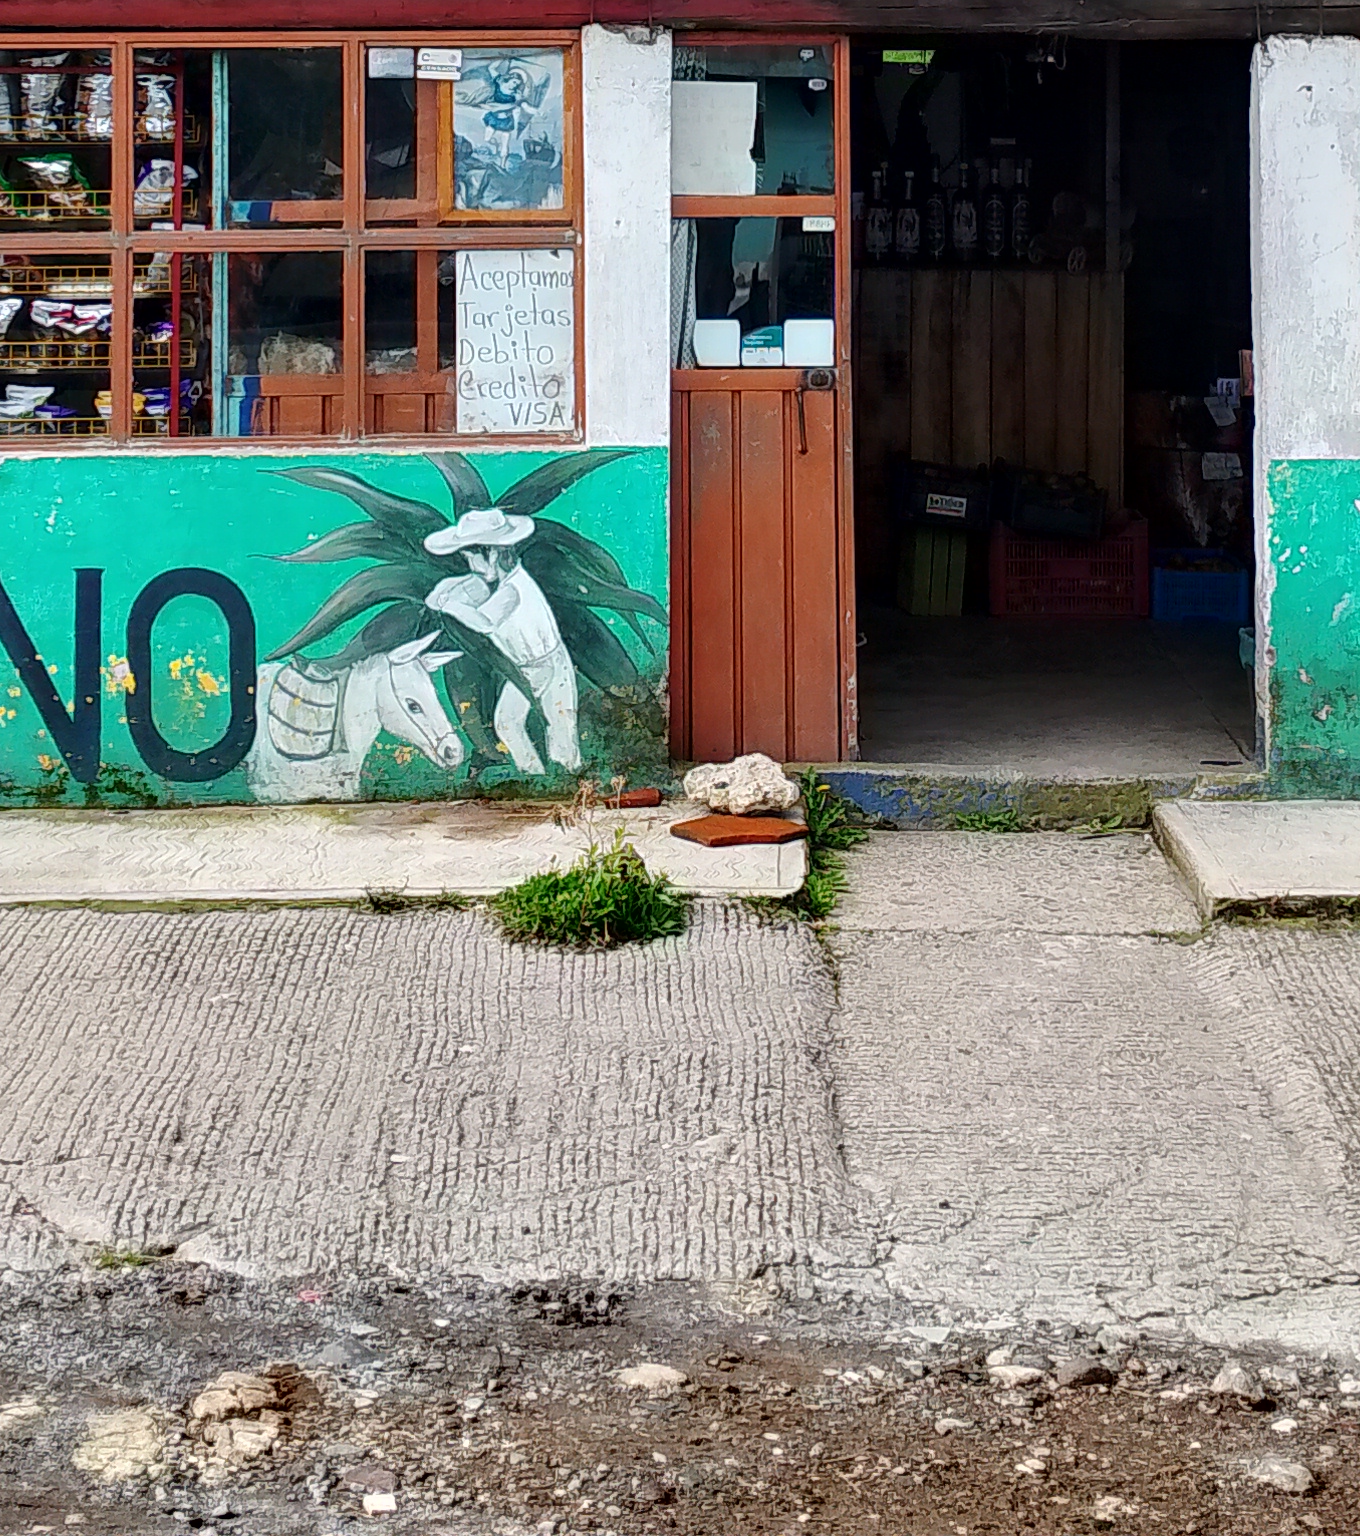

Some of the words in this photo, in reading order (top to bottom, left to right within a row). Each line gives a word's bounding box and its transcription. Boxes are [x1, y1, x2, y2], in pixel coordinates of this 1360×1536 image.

[459, 252, 574, 298] Aceptamos
[458, 290, 571, 338] Tarjetas
[459, 330, 554, 366] Debito
[458, 364, 561, 401] Credito
[504, 400, 565, 426] VISA
